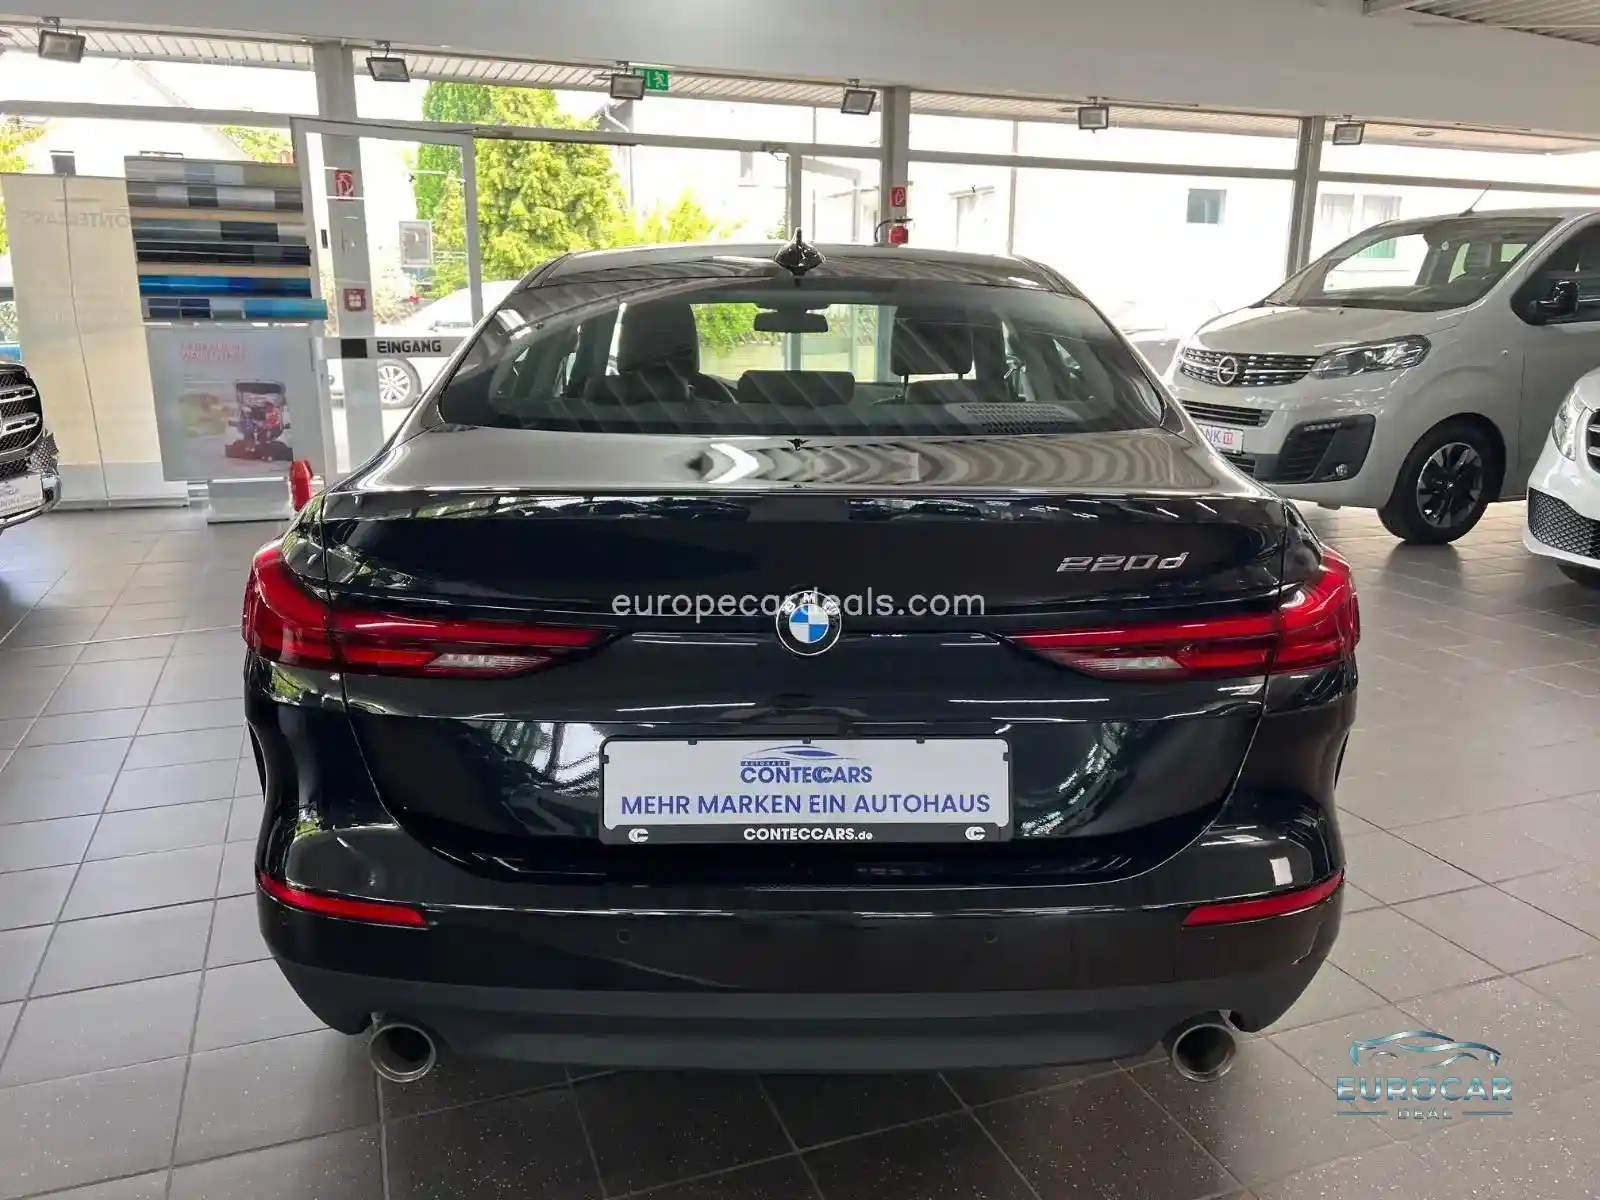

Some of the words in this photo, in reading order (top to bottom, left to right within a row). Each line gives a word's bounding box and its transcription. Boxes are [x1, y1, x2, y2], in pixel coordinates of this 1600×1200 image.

[376, 339, 442, 354] EINGANG
[1056, 551, 1190, 573] 220d
[621, 795, 690, 815] MEHR
[698, 794, 801, 814] MARKEN
[809, 793, 846, 813] EIN
[854, 793, 991, 813] AUTOHAUS
[743, 827, 874, 841] CONTECCARS.de
